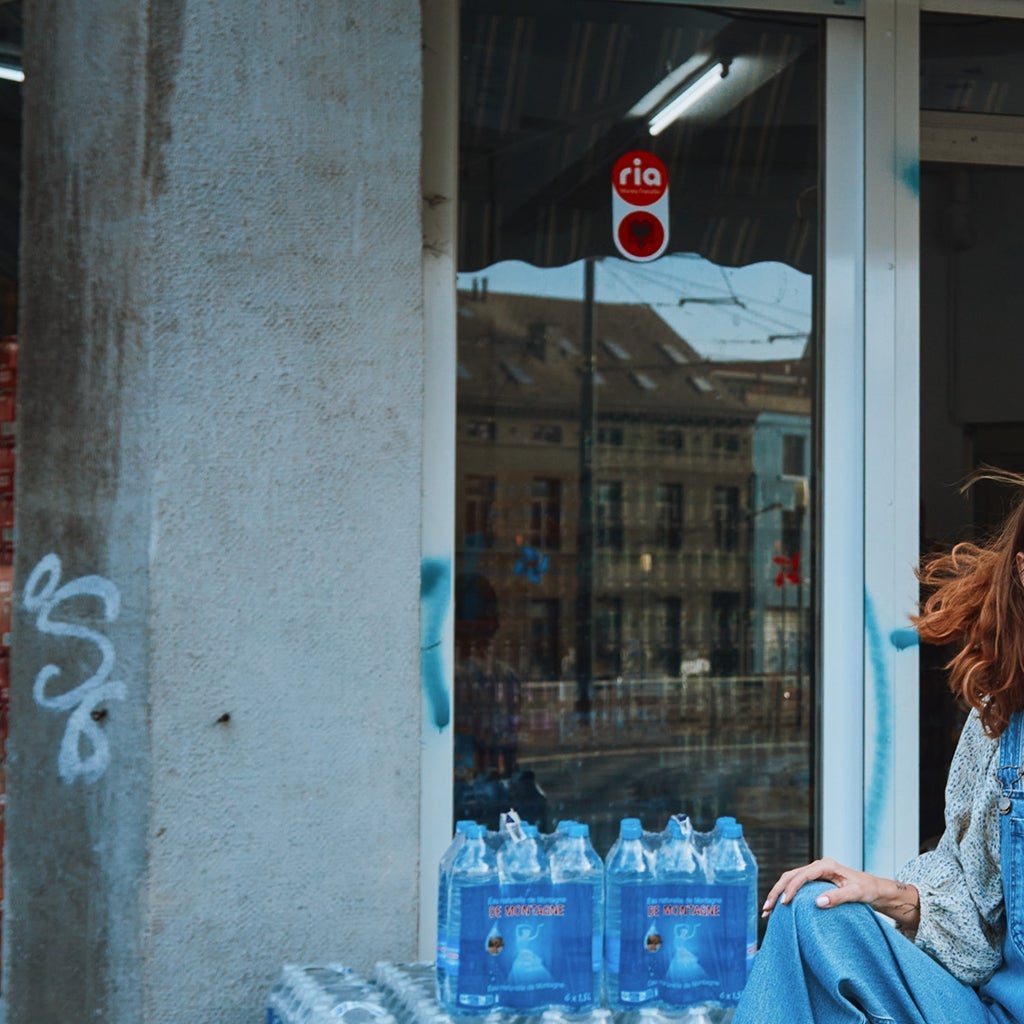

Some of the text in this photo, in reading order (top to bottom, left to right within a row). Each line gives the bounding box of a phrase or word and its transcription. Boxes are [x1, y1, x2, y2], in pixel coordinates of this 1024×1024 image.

[619, 158, 662, 186] ria
[489, 904, 565, 918] DE MONTAGNE
[647, 904, 721, 917] DE MONTAGNE
